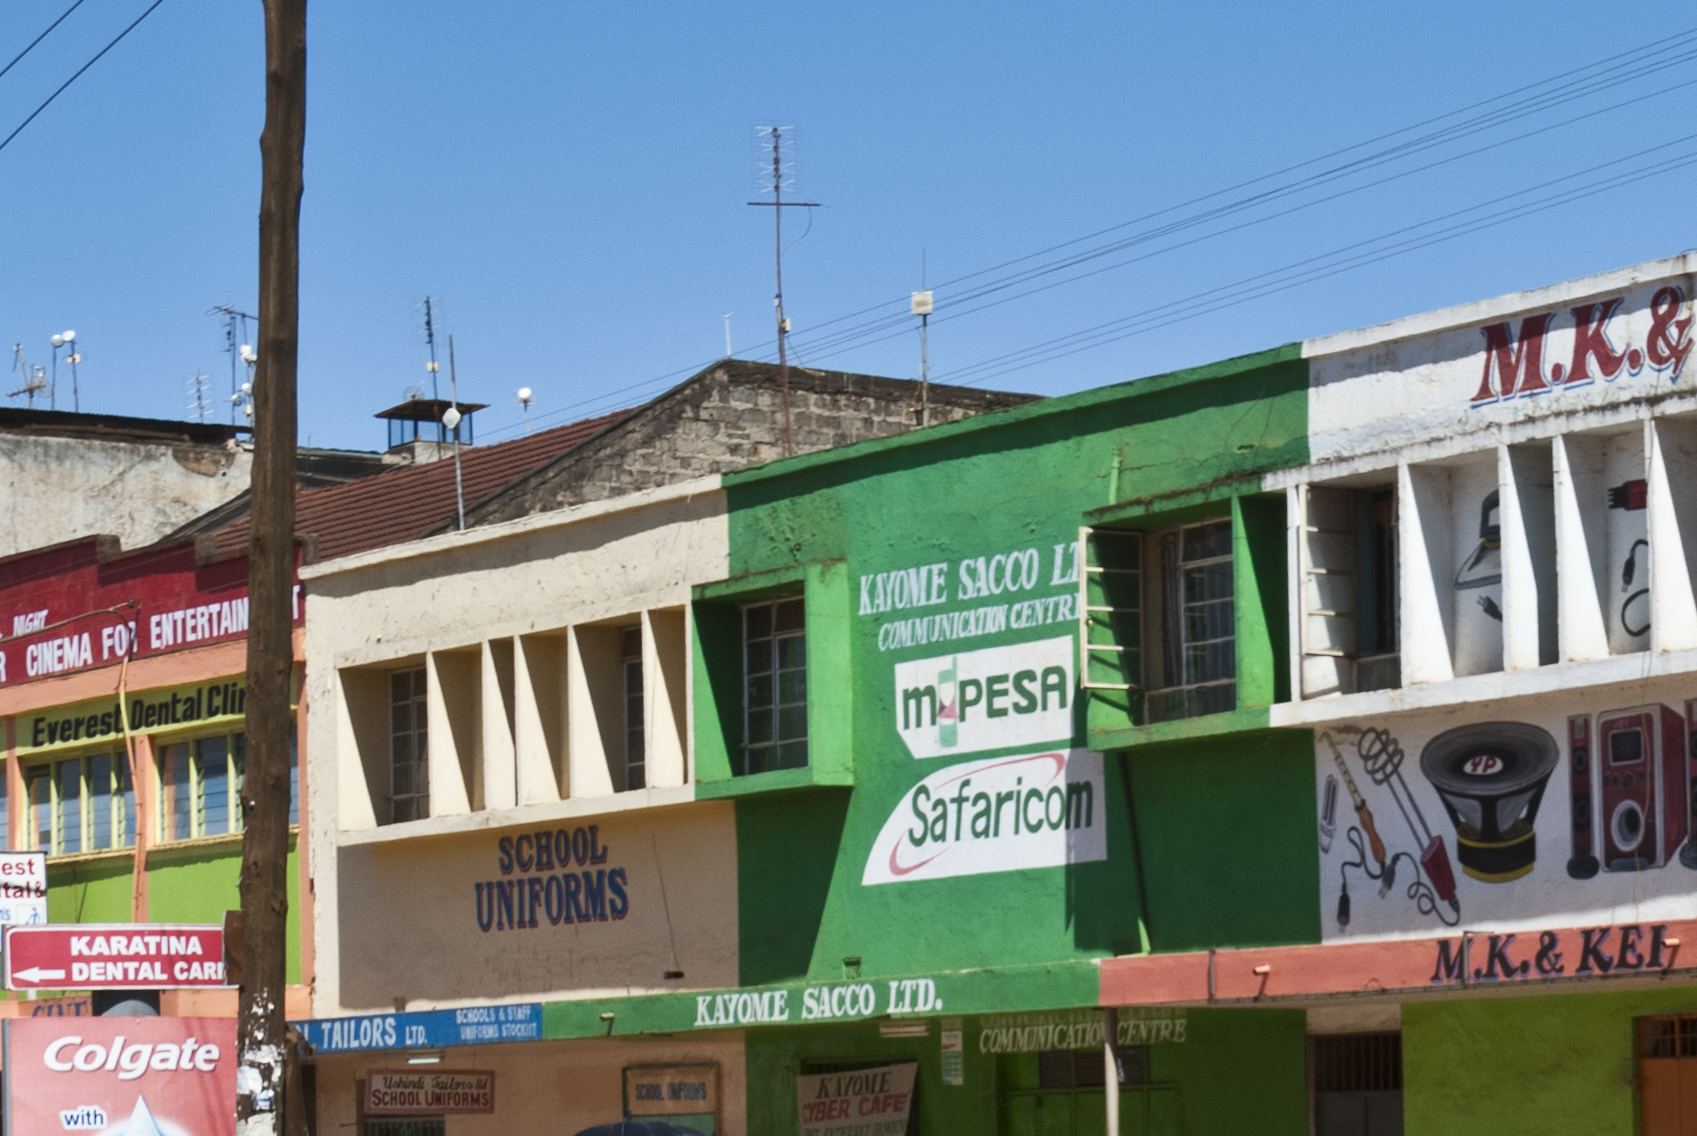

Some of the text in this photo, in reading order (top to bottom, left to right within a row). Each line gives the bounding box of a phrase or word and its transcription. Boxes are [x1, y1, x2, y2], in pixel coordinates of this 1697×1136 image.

[858, 540, 1081, 615] KAYOME SACCO LT
[878, 603, 1007, 651] COMMUNICATION
[26, 632, 93, 677] CINEMA
[102, 620, 138, 660] FOR
[33, 702, 125, 748] Everest
[131, 688, 199, 731] Dental
[908, 777, 1093, 847] Safaricom
[498, 823, 609, 875] SCHOOL
[474, 866, 629, 932] UNIFORMS
[71, 936, 203, 956] KARATINA
[72, 961, 169, 981] DENTAL
[456, 1008, 495, 1024] SCHOOLS
[508, 1005, 532, 1021] STAFF
[694, 978, 943, 1027] KAYOME SACCO LTD.
[321, 1017, 396, 1049] TAILORS
[405, 1025, 428, 1045] LTD.
[1117, 1019, 1187, 1046] CENTRE
[43, 1035, 221, 1080] Colgate
[372, 1089, 490, 1107] SCHOOL UNIFORMS
[383, 1076, 425, 1089] Ushindi
[431, 1076, 473, 1091] Tailors
[816, 1071, 892, 1098] KAYOME
[64, 1109, 104, 1126] with
